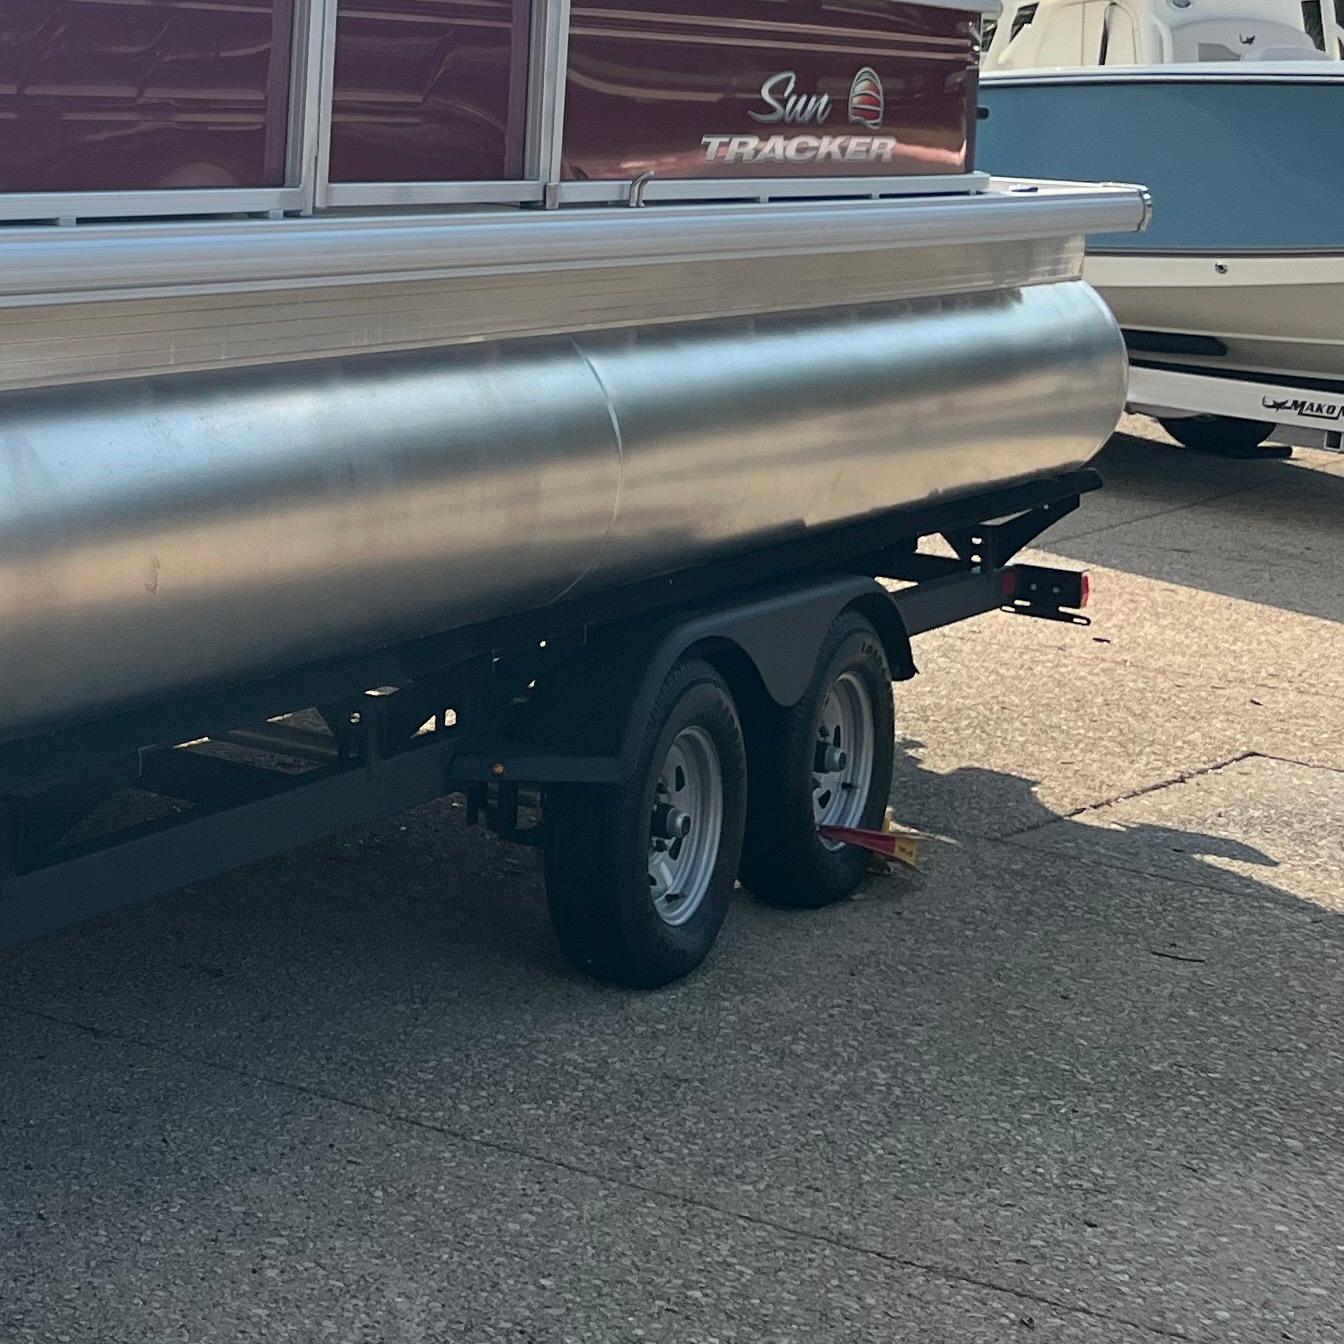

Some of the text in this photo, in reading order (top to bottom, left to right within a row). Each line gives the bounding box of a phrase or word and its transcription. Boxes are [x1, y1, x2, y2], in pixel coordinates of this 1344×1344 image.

[747, 70, 832, 125] Sun
[700, 134, 897, 164] TRACKER
[1291, 399, 1337, 420] MAKO
